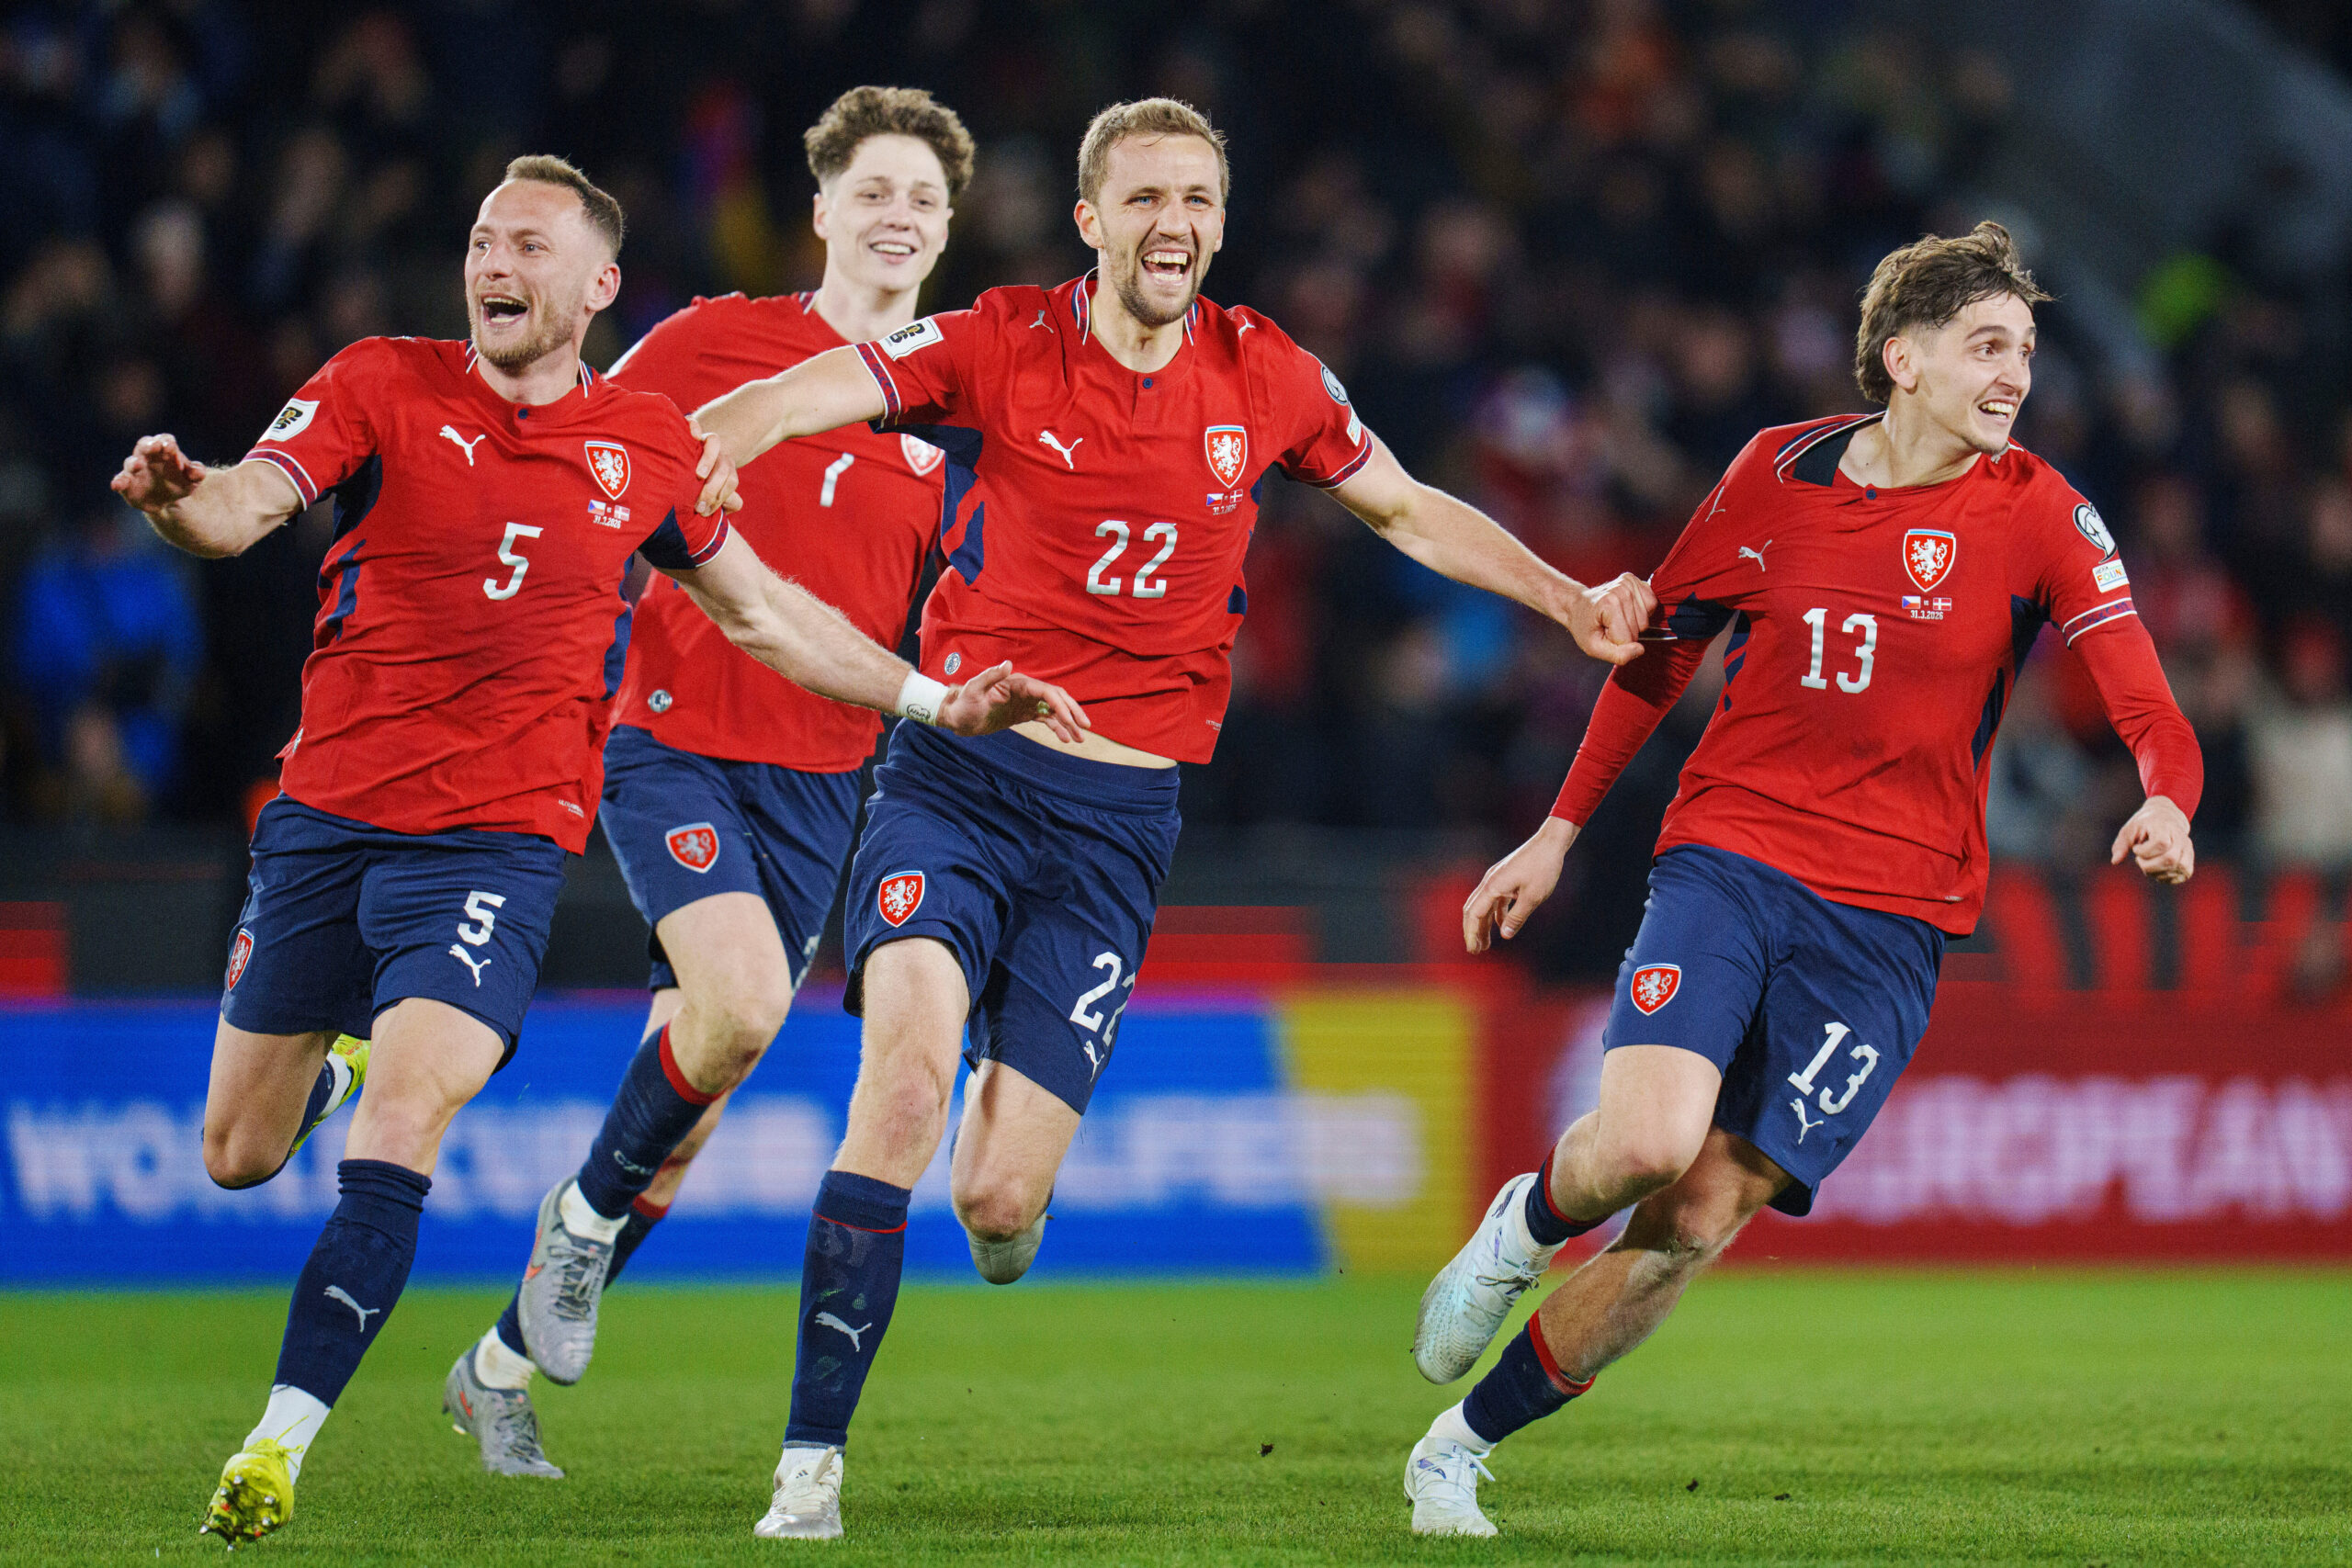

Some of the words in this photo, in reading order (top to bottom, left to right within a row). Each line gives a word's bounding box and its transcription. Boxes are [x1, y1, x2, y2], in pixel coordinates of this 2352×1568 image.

[482, 521, 544, 601] 5
[1085, 519, 1178, 599] 22
[2097, 569, 2125, 582] FOUN
[1800, 607, 1878, 694] 13
[1910, 609, 1944, 620] 31.3.2026
[457, 890, 506, 947] 5
[1787, 1021, 1881, 1115] 13
